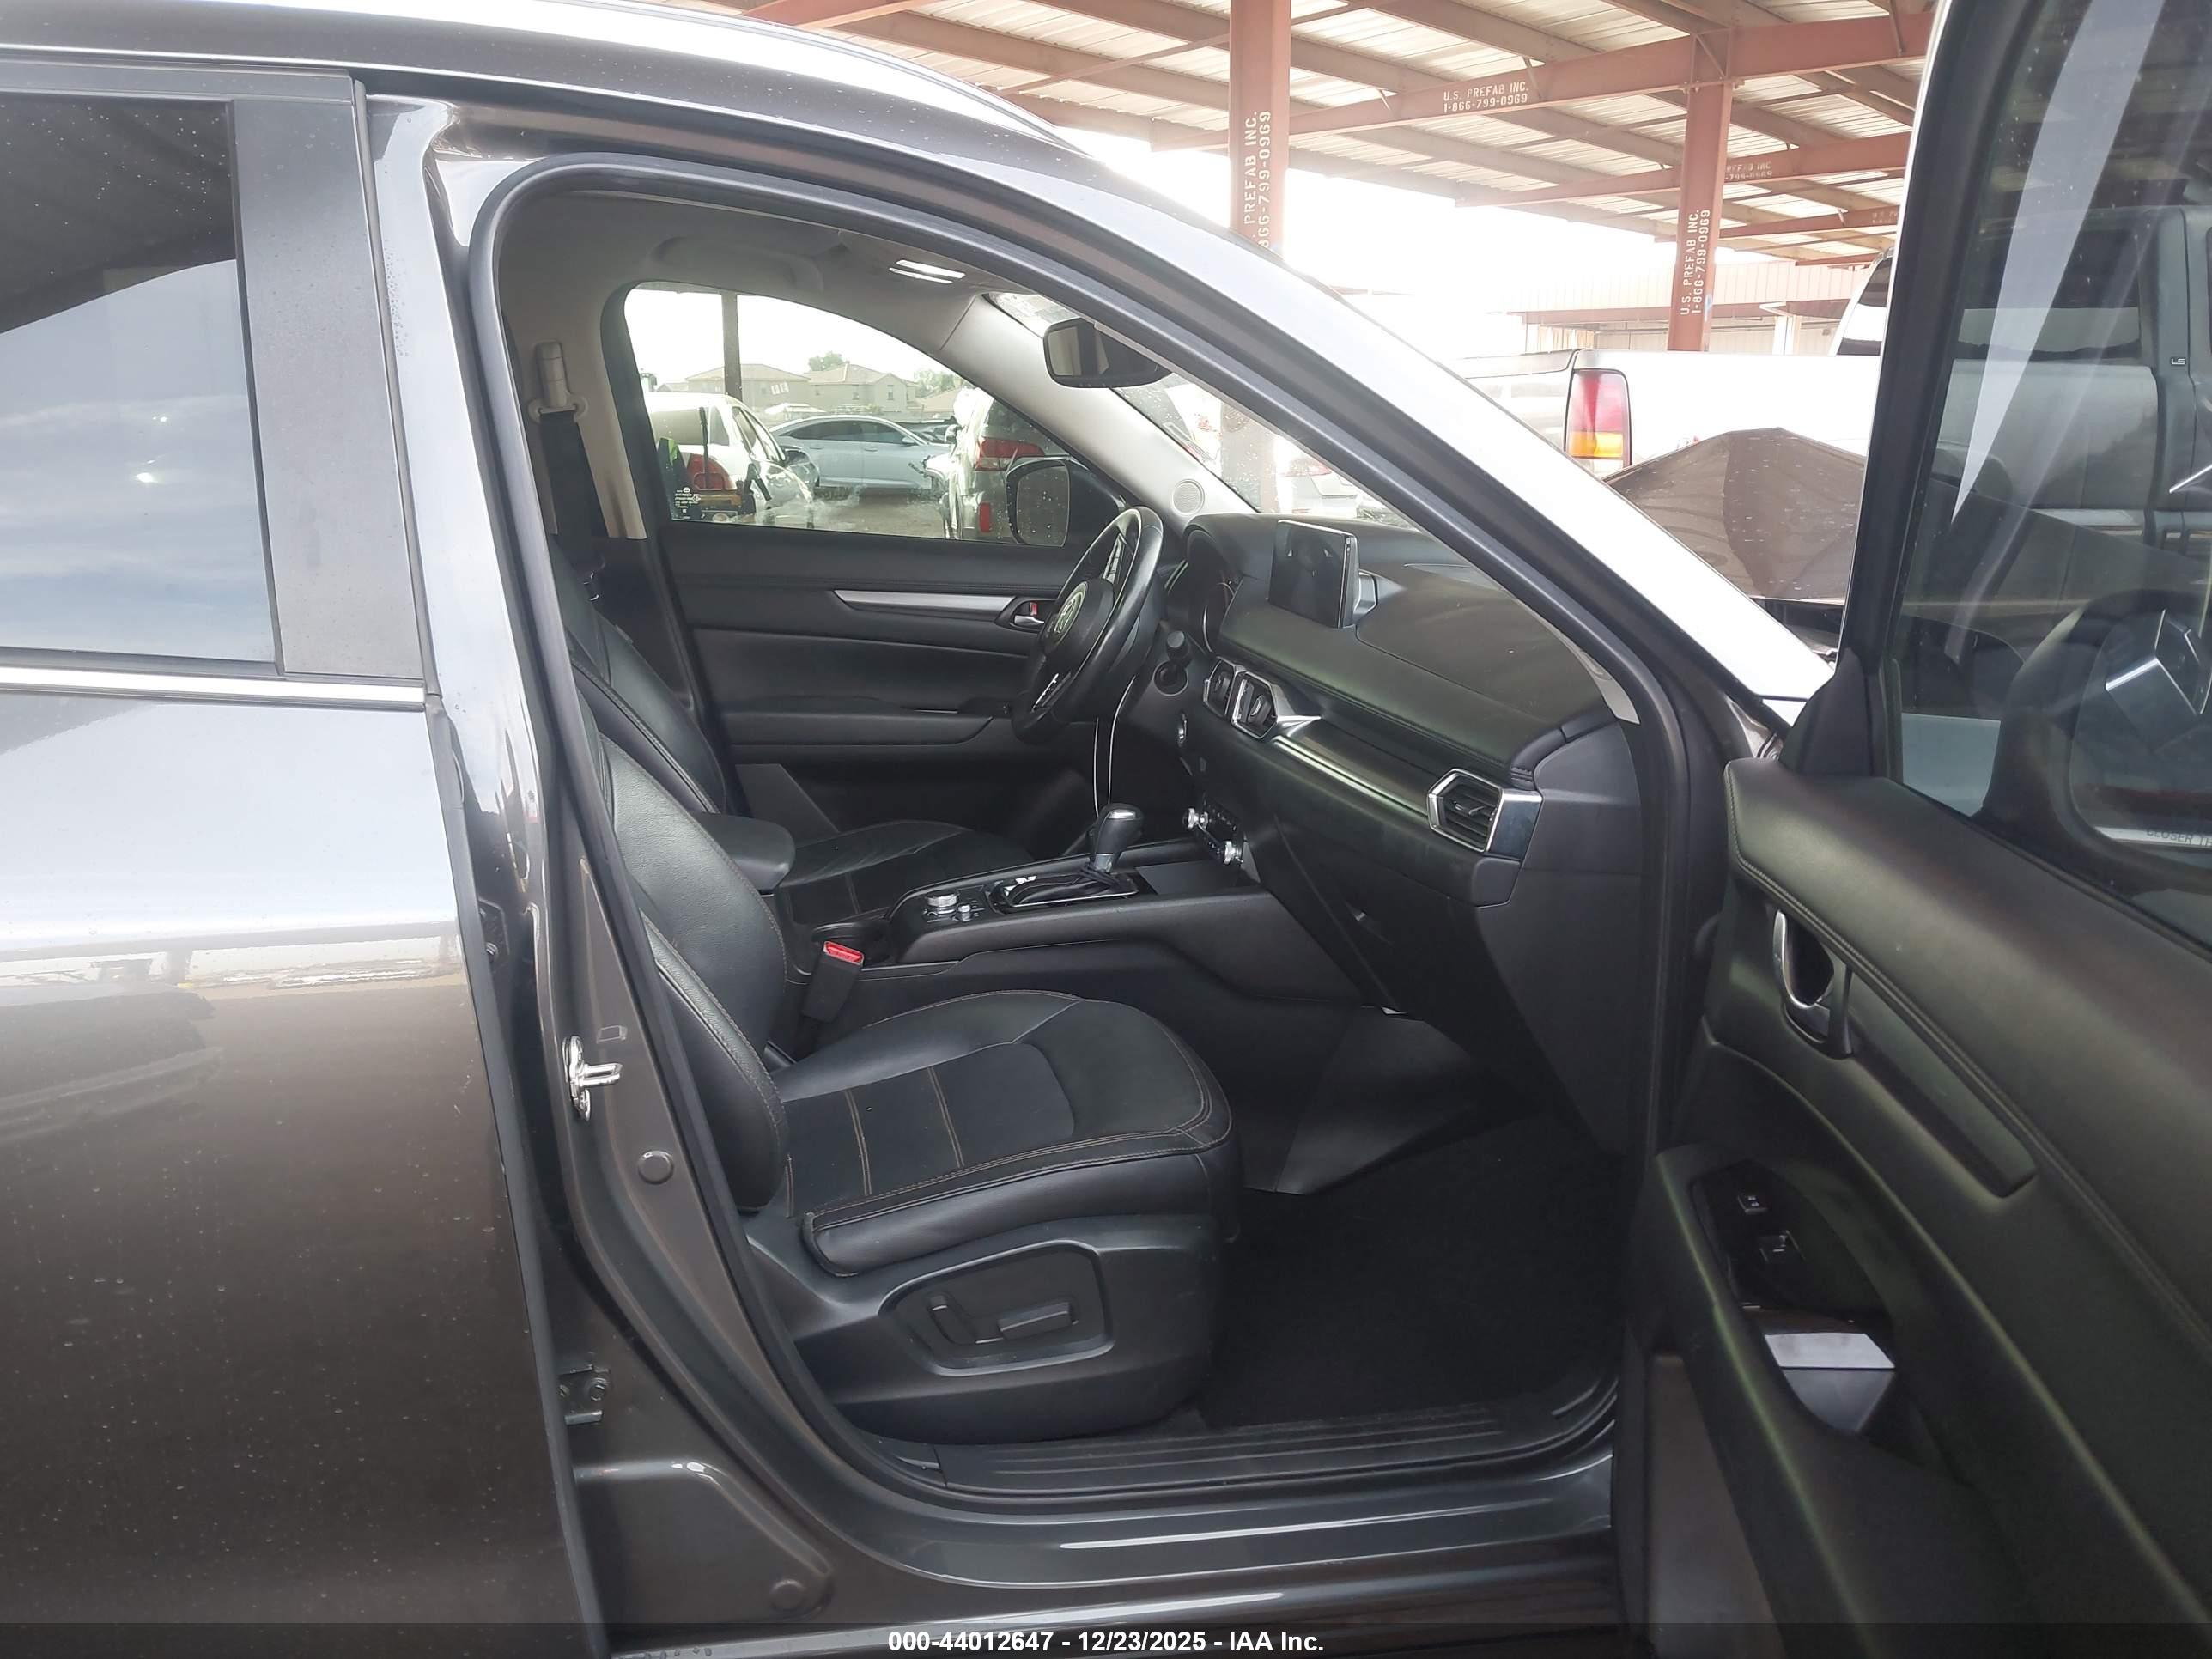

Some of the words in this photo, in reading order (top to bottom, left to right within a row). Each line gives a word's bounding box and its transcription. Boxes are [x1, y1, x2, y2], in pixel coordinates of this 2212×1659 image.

[1443, 90, 1462, 102] U.S.
[1467, 83, 1505, 98] PREFAB
[1510, 81, 1529, 93] INC.
[1443, 93, 1528, 113] 1-866-799-0969
[1245, 111, 1258, 146] INC.
[1243, 155, 1257, 224] PREFAB
[1258, 111, 1272, 249] 866-799-0969
[1687, 210, 1699, 233] INC.
[1683, 240, 1697, 286] PREFAB
[1692, 210, 1711, 313] 1-866-799-0969
[1680, 292, 1692, 315] U.S.
